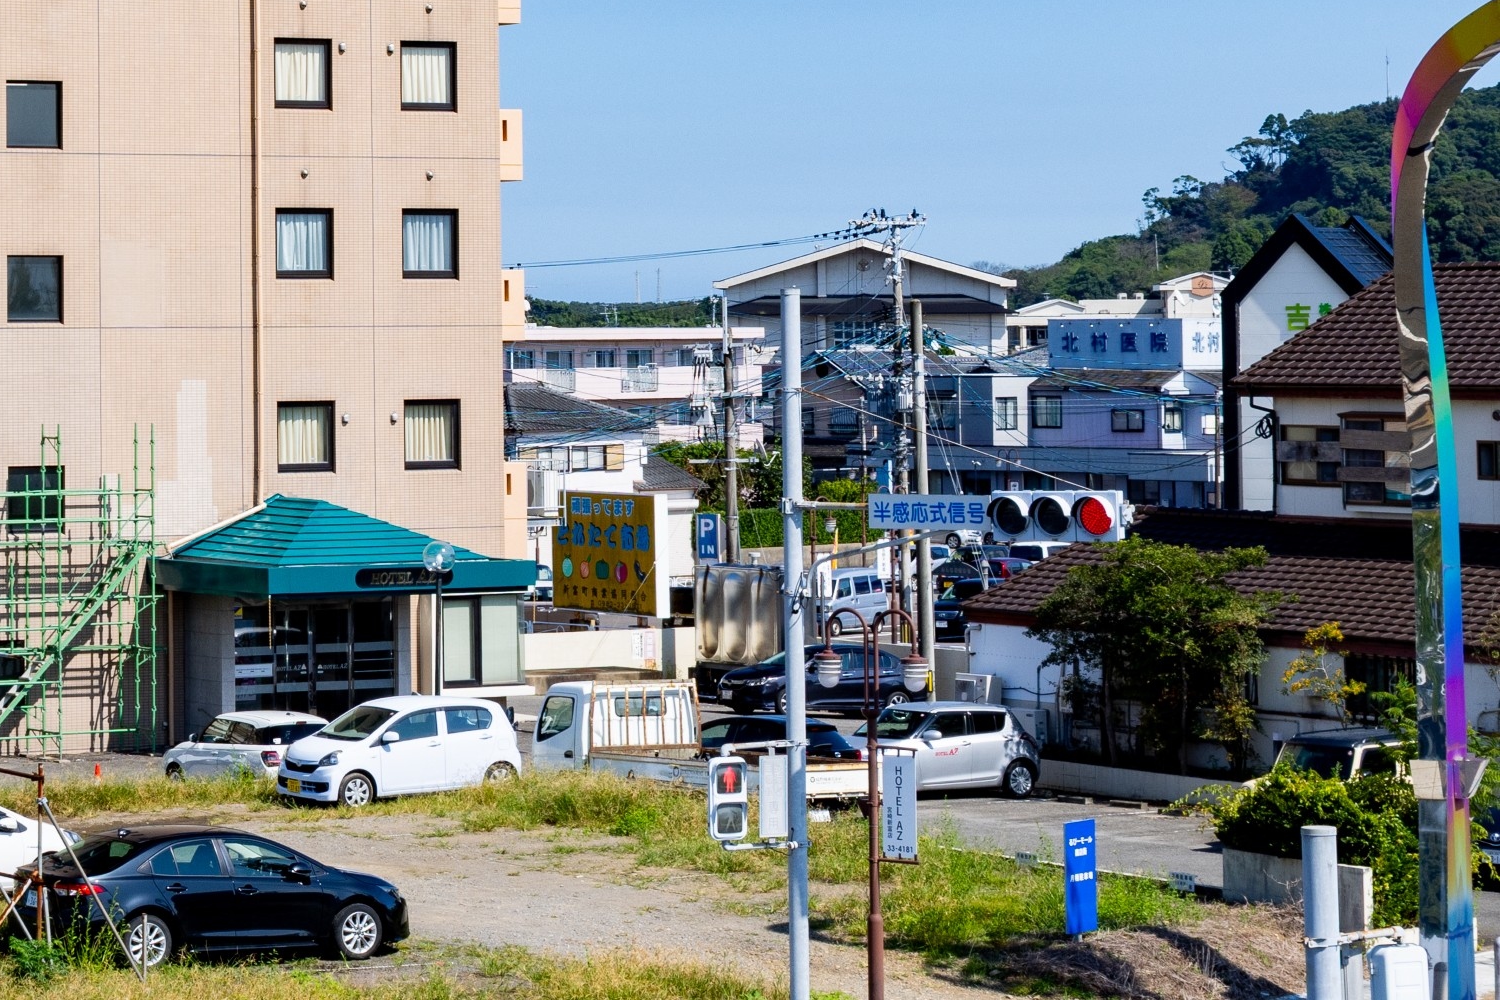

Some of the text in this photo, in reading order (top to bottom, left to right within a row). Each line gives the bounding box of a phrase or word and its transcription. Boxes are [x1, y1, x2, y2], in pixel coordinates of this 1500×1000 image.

[1062, 332, 1169, 353] 北村医院
[571, 497, 635, 517] 頑張ってます
[873, 501, 985, 524] 半感応式信号
[700, 518, 714, 538] P
[701, 545, 715, 554] IN
[370, 568, 437, 584] HOTEL AZ
[895, 766, 904, 840] HOTEL AZ
[887, 844, 913, 853] 33-4181
